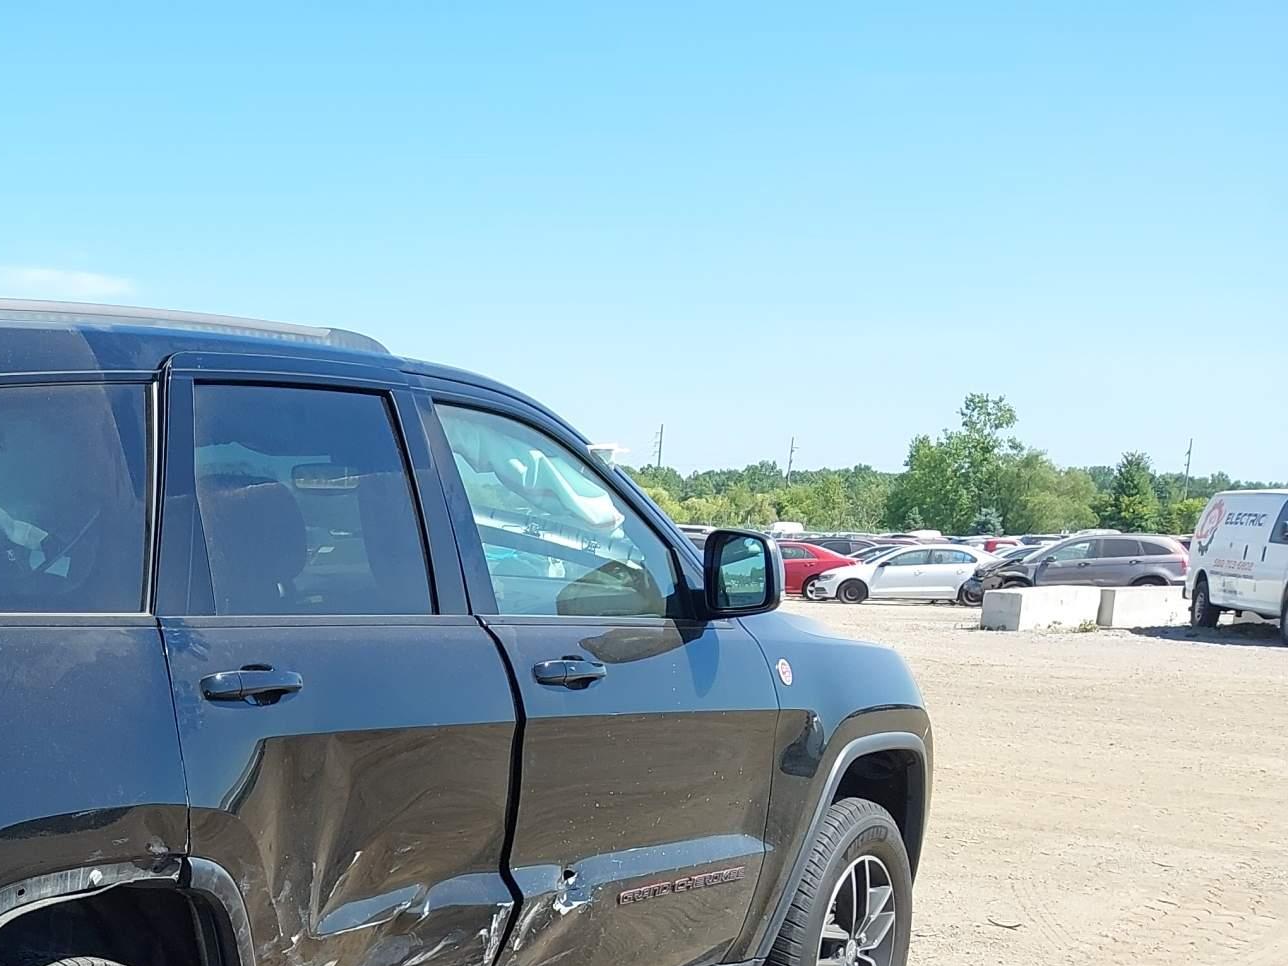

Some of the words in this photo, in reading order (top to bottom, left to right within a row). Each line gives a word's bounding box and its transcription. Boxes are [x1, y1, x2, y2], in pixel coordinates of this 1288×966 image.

[1224, 512, 1267, 526] ELECTRIC
[617, 881, 673, 905] GRAND
[674, 866, 746, 893] CHEROKEE
